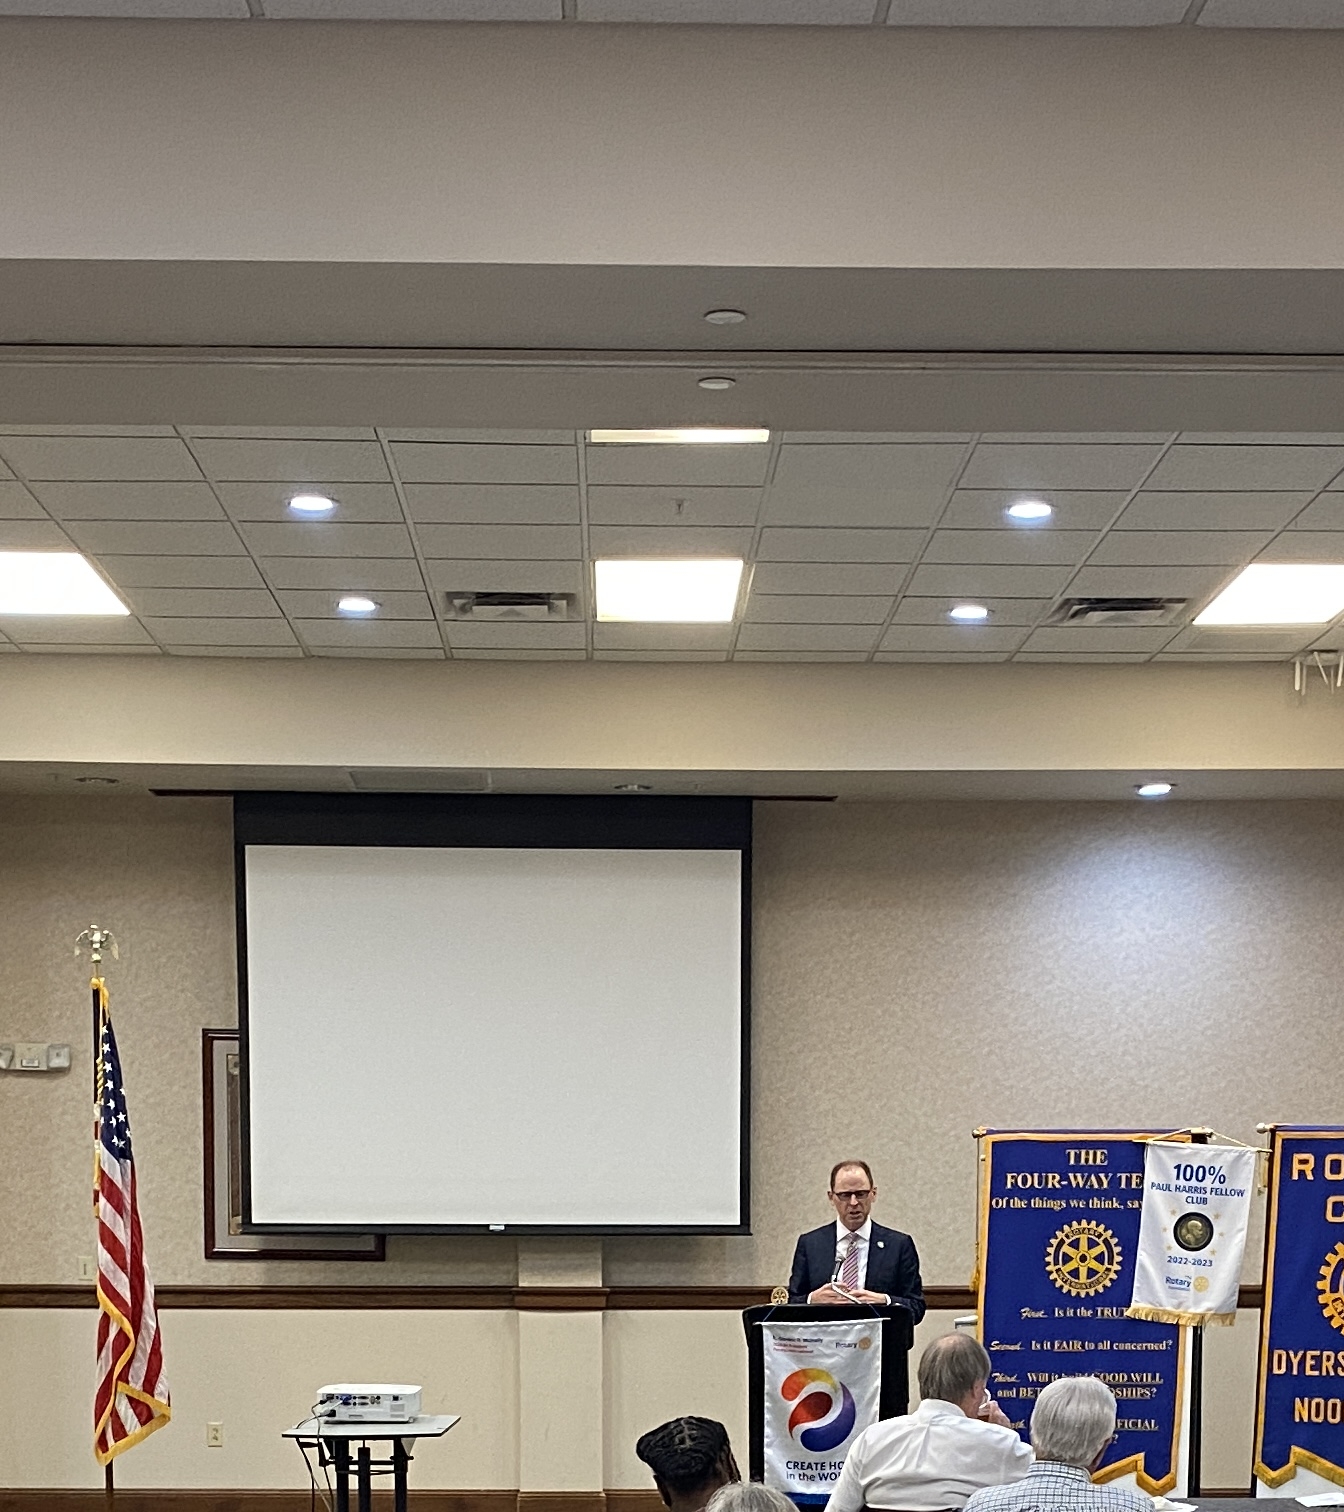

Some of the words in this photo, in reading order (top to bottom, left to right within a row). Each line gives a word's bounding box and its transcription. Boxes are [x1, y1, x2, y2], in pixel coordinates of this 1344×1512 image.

[1066, 1149, 1109, 1166] THE
[1173, 1163, 1226, 1185] 100%
[1005, 1172, 1114, 1190] FOUR-WAY
[1117, 1172, 1144, 1190] TE
[1150, 1181, 1173, 1193] PAUL
[1174, 1184, 1208, 1195] HARRIS
[1209, 1187, 1246, 1198] FELLOW
[991, 1197, 1007, 1209] Of
[1010, 1197, 1028, 1209] the
[1030, 1196, 1067, 1211] things
[1069, 1199, 1087, 1209] we
[1089, 1196, 1124, 1211] think,
[1185, 1195, 1208, 1206] CLUB
[1166, 1255, 1213, 1267] 2022-2023
[1165, 1276, 1192, 1288] Rotary
[1054, 1307, 1065, 1318] Is
[1066, 1307, 1074, 1318] it
[1076, 1307, 1094, 1318] the
[1095, 1307, 1130, 1319] TRUT
[1031, 1340, 1041, 1351] Is
[1043, 1340, 1052, 1351] it
[1054, 1340, 1084, 1351] FAIR
[1085, 1340, 1096, 1351] to
[1097, 1340, 1111, 1351] all
[1113, 1339, 1173, 1351] concerned?
[1130, 1372, 1164, 1384] WILL
[997, 1387, 1017, 1398] and
[1019, 1387, 1043, 1399] BET
[1111, 1387, 1158, 1399] SHIPS?
[1116, 1418, 1159, 1431] FICIAL
[785, 1460, 826, 1471] CREATE
[828, 1460, 845, 1471] HO
[798, 1471, 816, 1482] the
[817, 1471, 841, 1482] WO
